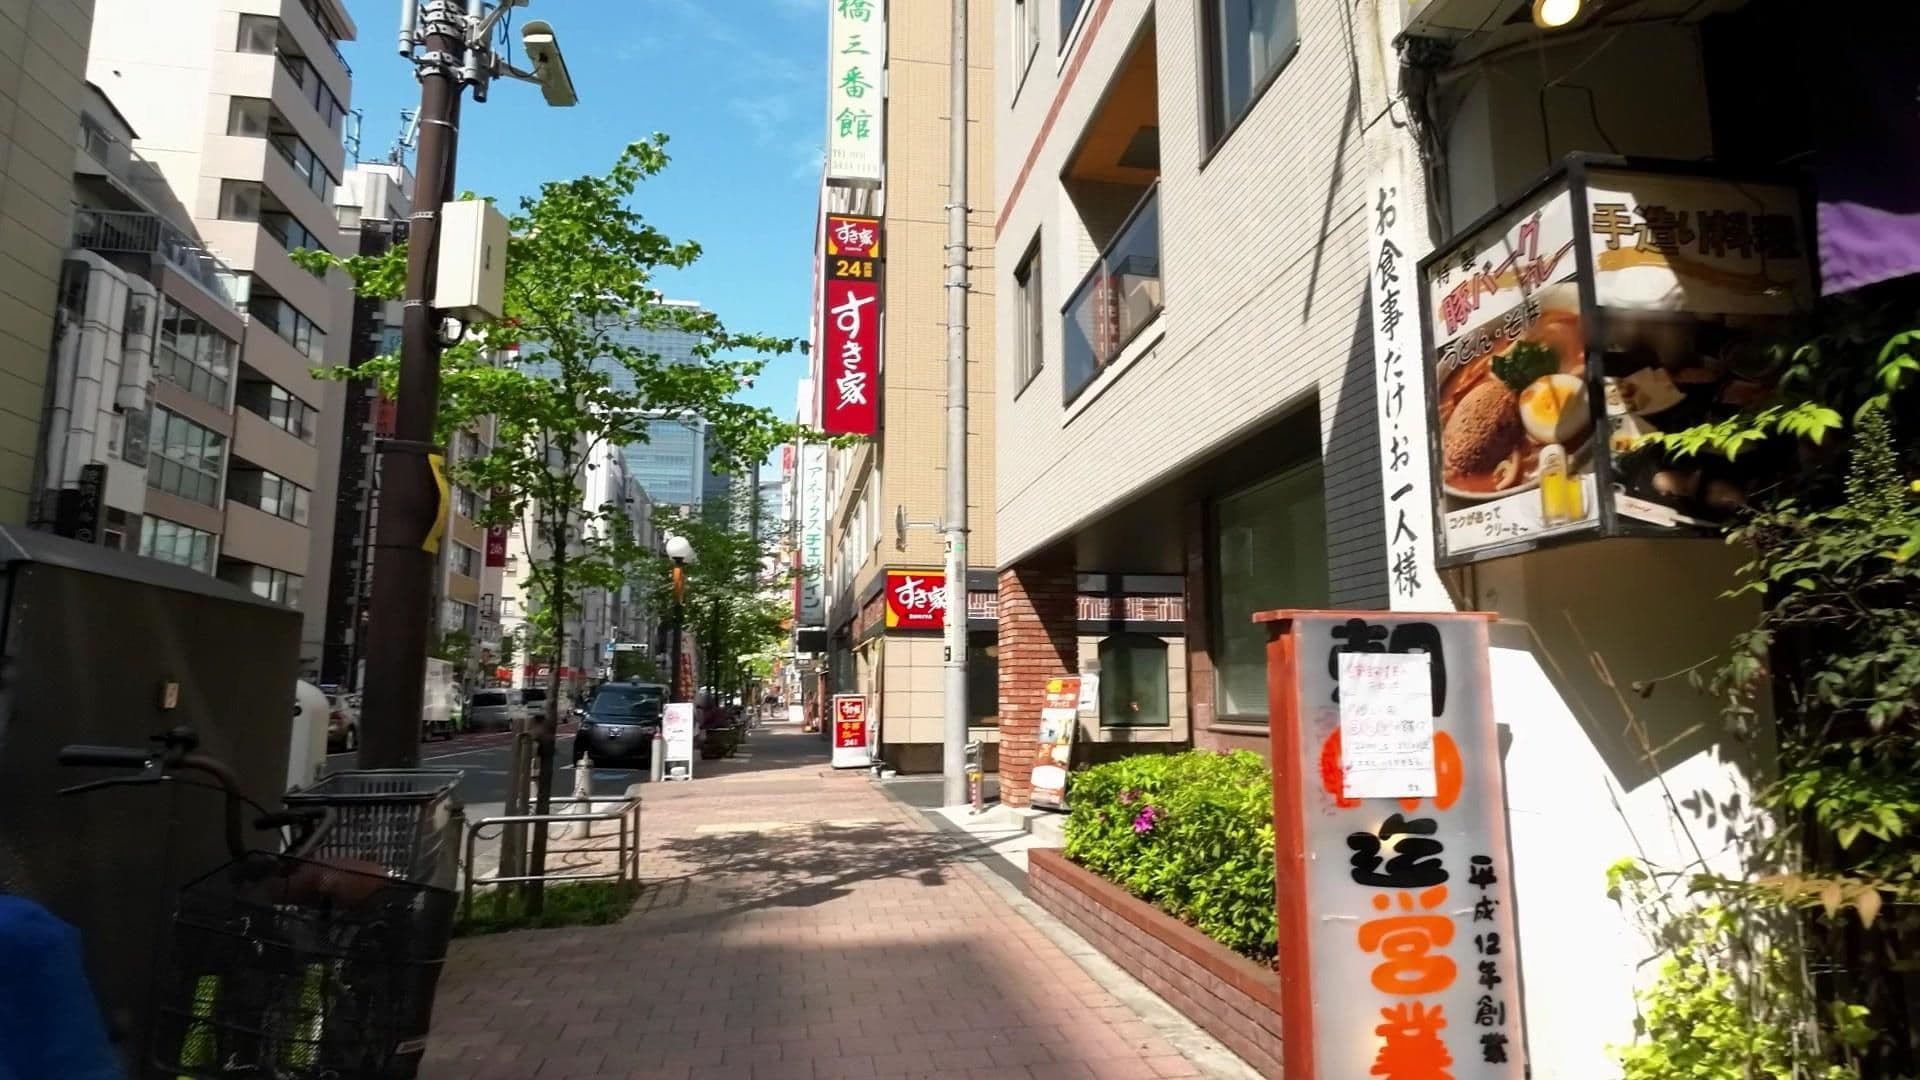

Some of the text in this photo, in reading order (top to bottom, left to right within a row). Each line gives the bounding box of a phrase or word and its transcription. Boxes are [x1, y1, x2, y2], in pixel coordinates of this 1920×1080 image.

[836, 0, 875, 140] 橋三番館
[834, 220, 874, 248] すき家
[831, 290, 876, 411] すき家
[1467, 855, 1509, 1064] 平成12年創業
